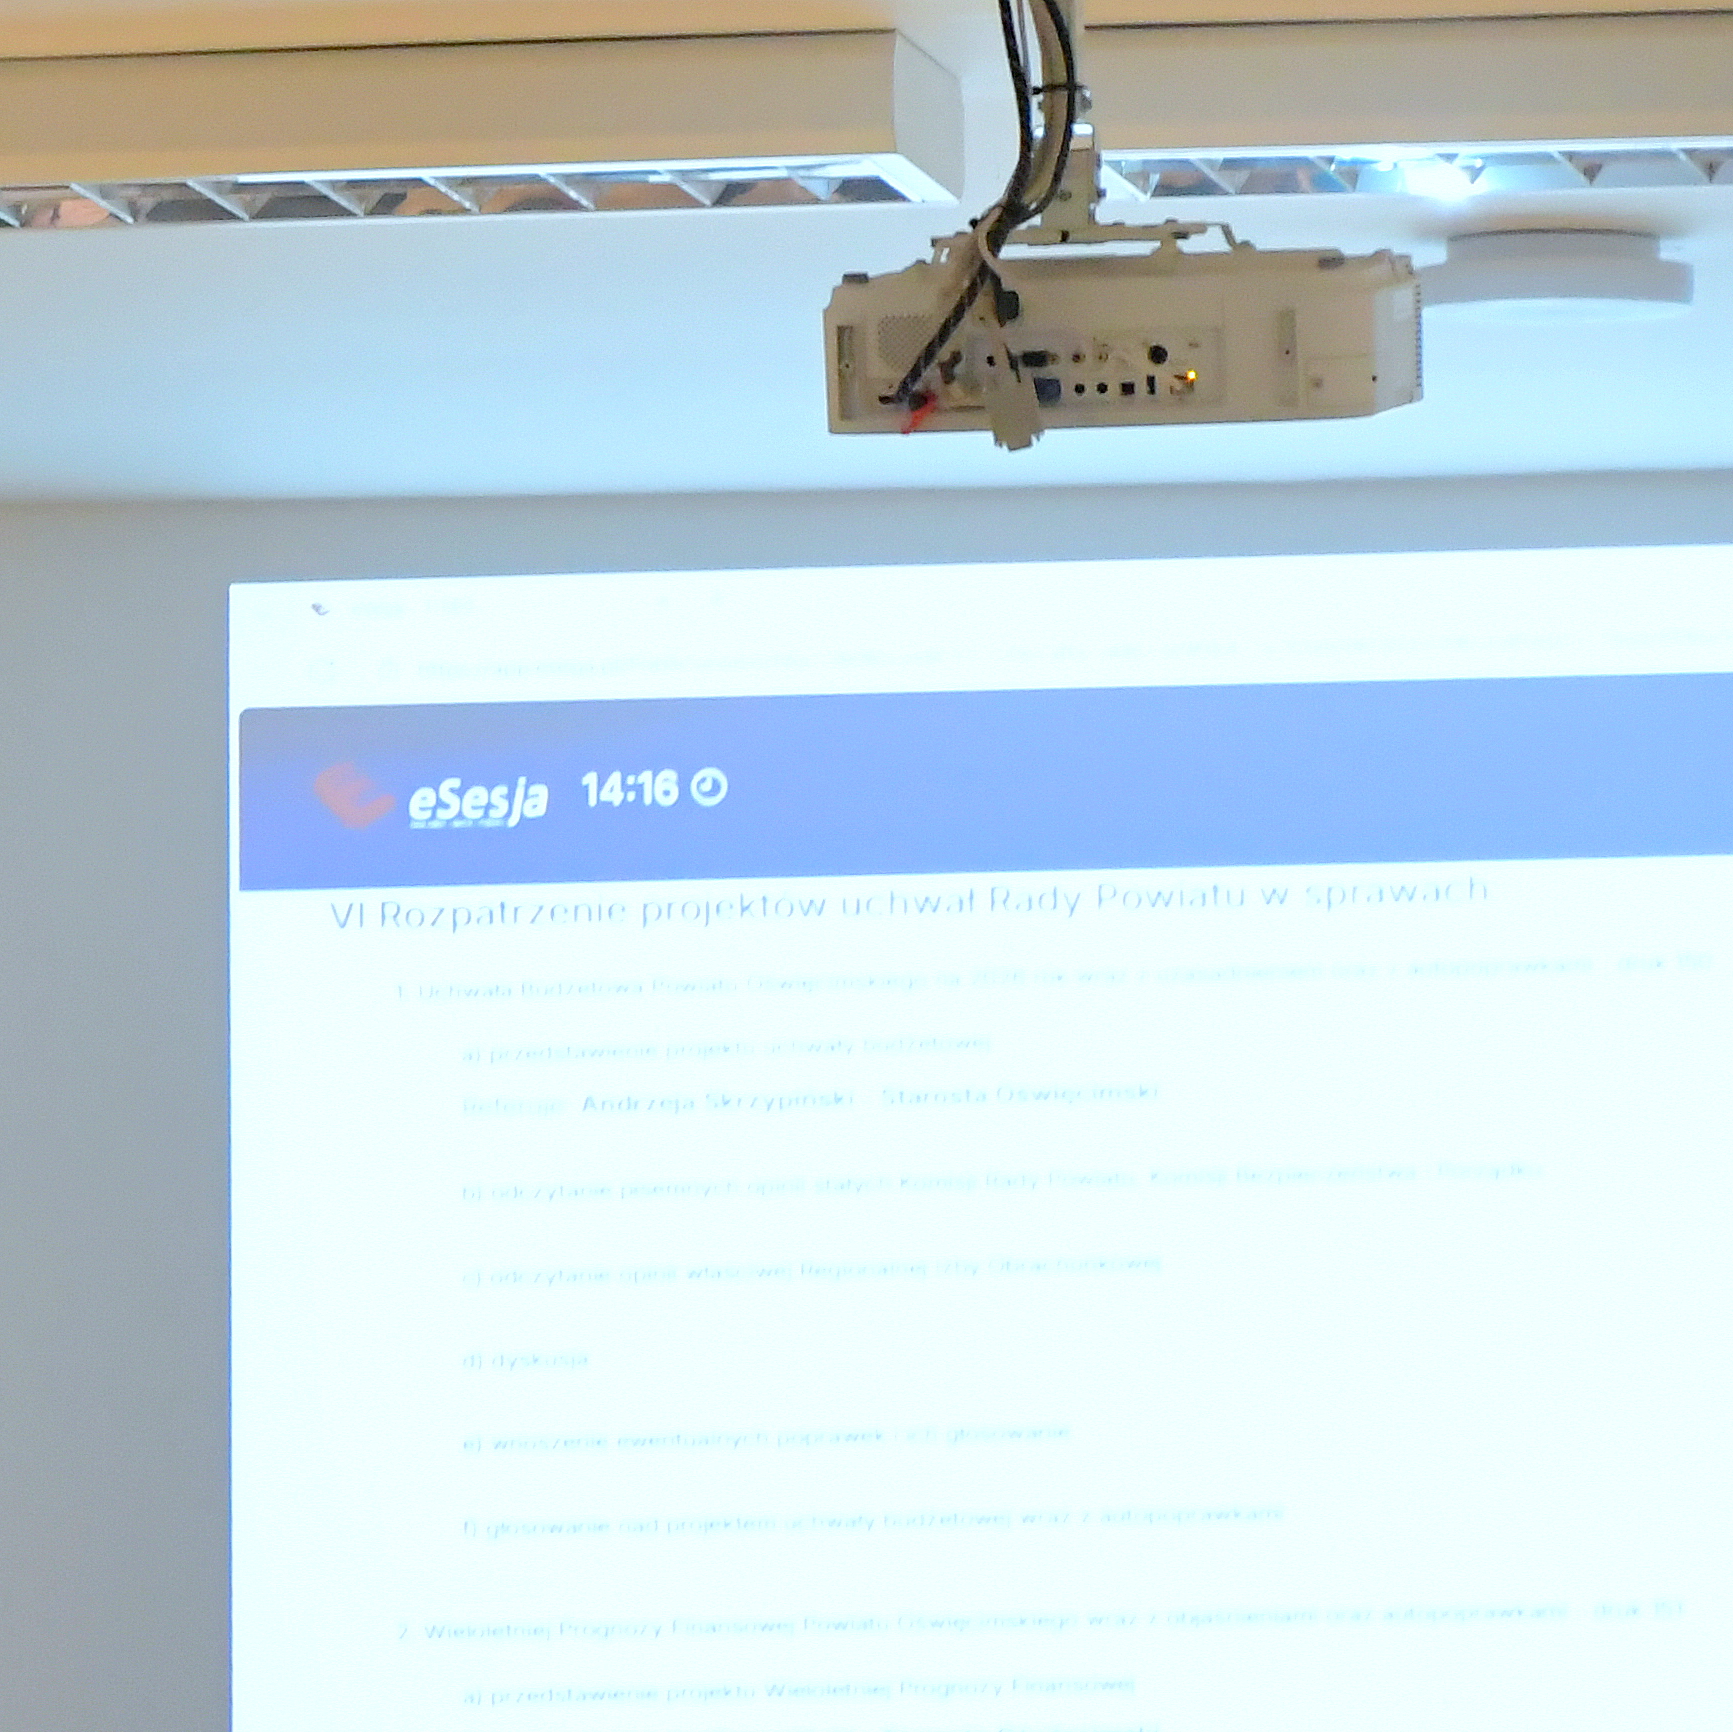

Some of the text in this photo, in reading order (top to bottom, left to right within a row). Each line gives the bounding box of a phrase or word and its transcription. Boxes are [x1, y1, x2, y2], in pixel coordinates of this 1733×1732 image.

[408, 776, 549, 828] eSesja
[581, 769, 679, 807] 14:16
[378, 896, 629, 932] Rozpatrzenie
[640, 891, 827, 926] projektów
[839, 887, 978, 916] uchwał
[989, 885, 1082, 918] Rady
[1096, 881, 1247, 910] Powiatu
[1259, 885, 1291, 907] w
[1302, 875, 1491, 910] sprawach
